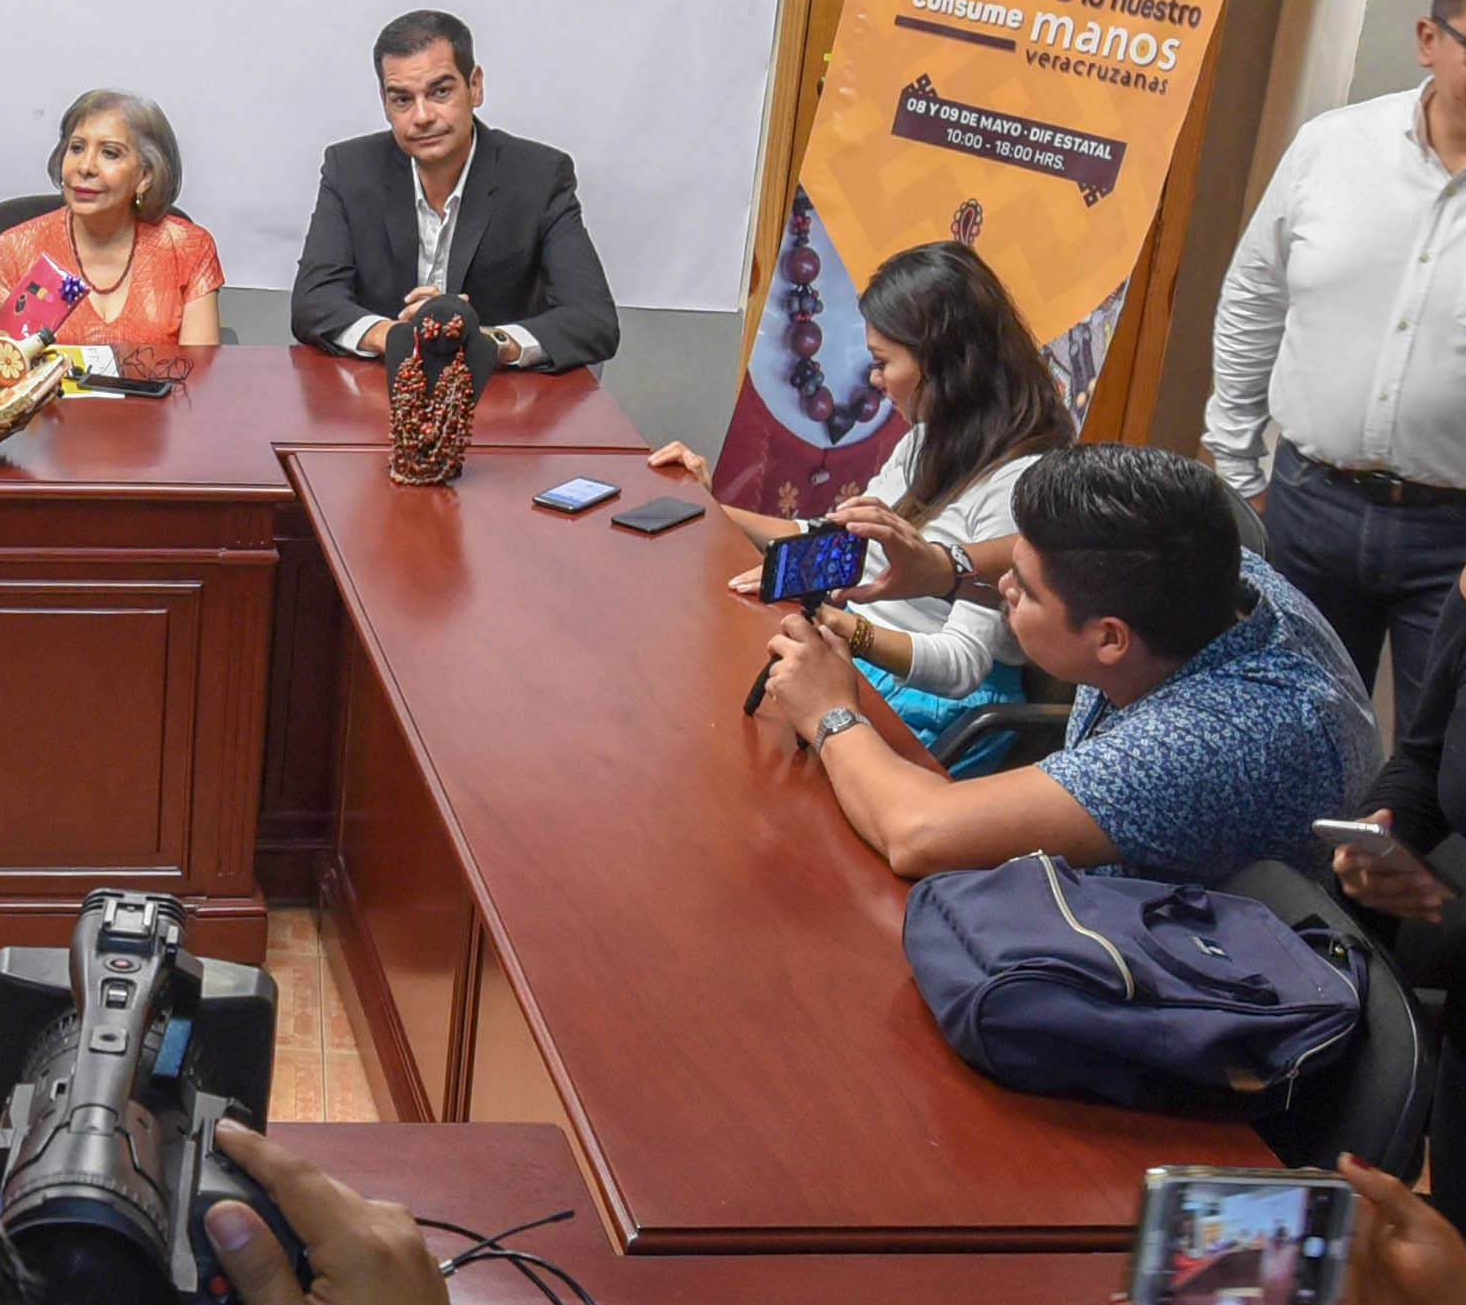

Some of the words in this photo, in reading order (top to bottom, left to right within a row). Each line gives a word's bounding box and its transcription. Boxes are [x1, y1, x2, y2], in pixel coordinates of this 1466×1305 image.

[1030, 10, 1181, 71] manos
[1025, 48, 1169, 95] veracruzanas
[907, 98, 926, 114] 08
[928, 103, 940, 116] Y
[940, 105, 959, 121] 09
[960, 110, 978, 127] DE
[979, 115, 1022, 136] MAYO
[1029, 127, 1055, 144] DIF
[1054, 133, 1112, 160] ESTATAL
[946, 128, 983, 149] 10:00
[995, 140, 1032, 161] 18:00
[1034, 151, 1065, 171] HRS.
